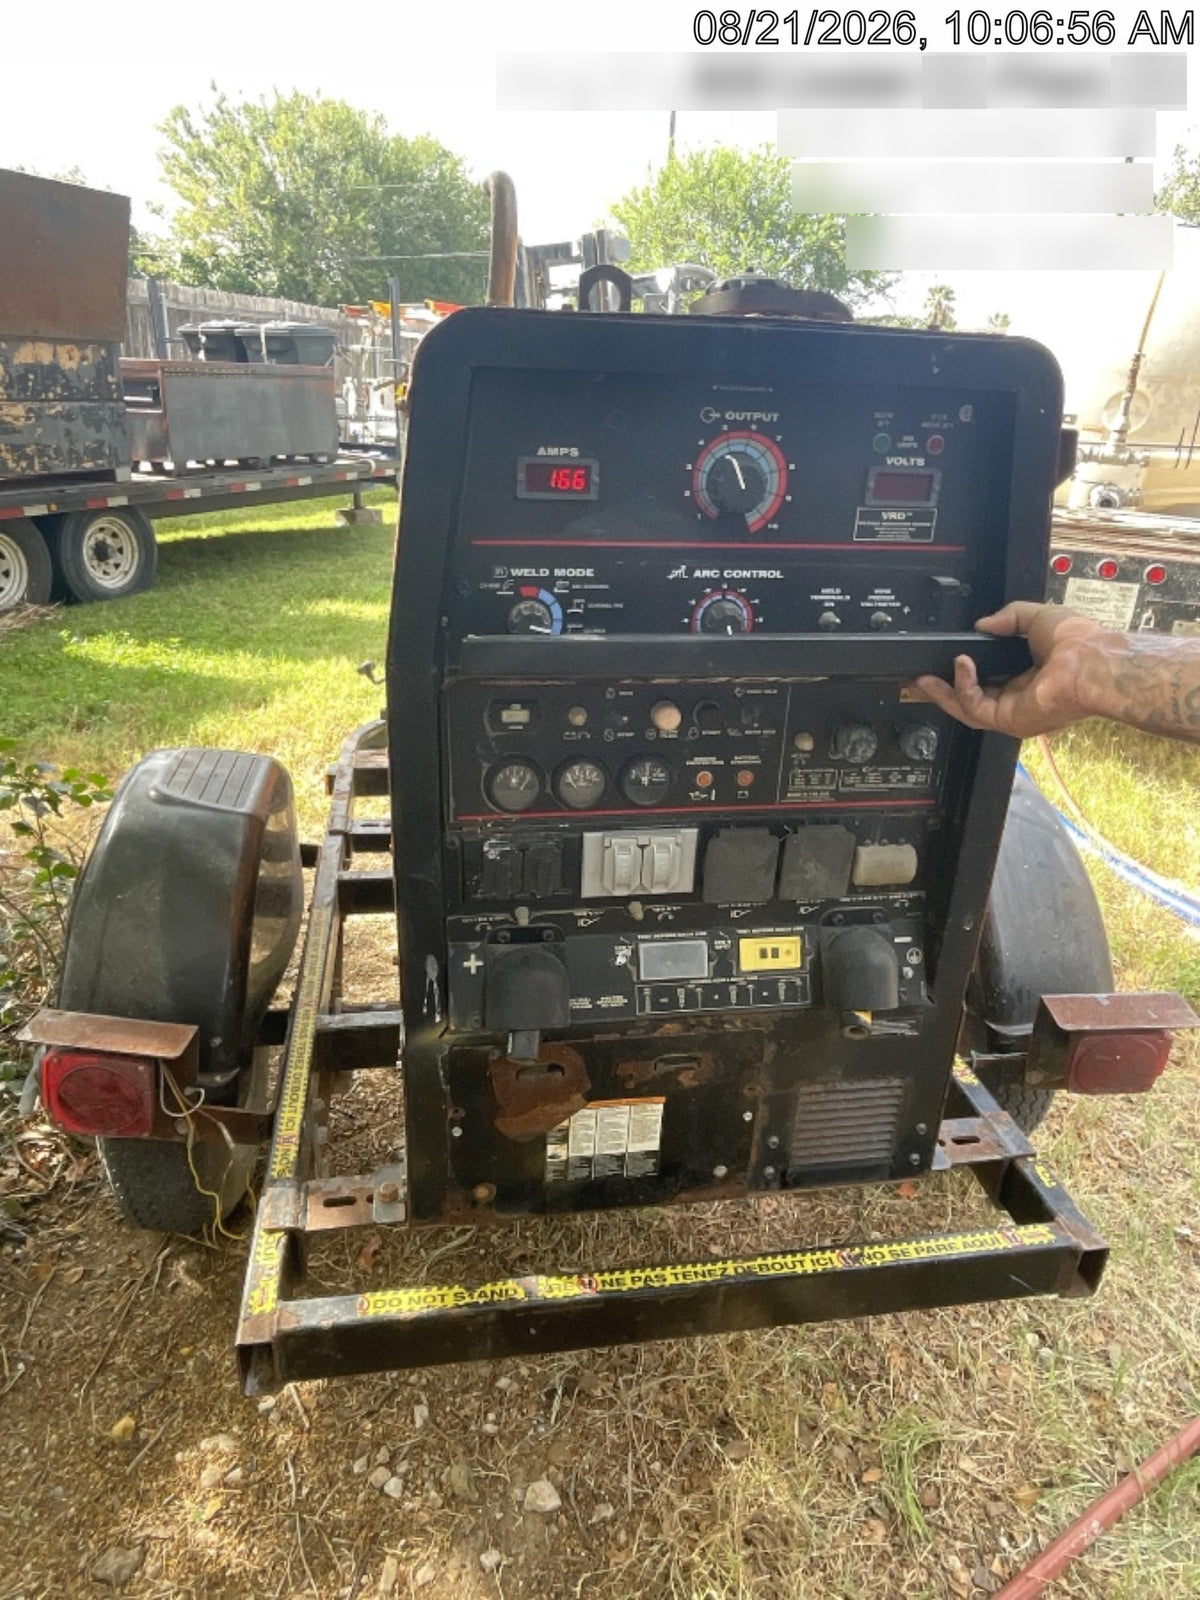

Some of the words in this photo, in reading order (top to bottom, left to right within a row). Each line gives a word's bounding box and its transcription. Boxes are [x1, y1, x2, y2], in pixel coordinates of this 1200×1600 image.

[724, 411, 780, 422] OUTPUT
[536, 446, 580, 457] AMPS
[886, 456, 926, 467] VOLTS
[550, 469, 587, 490] 166
[510, 568, 550, 577] WELD
[553, 568, 595, 577] MODE
[693, 570, 720, 578] ARC
[723, 570, 784, 578] CONTROL
[888, 1248, 912, 1258] SE
[914, 1242, 959, 1256] PARE
[963, 1236, 1001, 1249] AQUI
[602, 1277, 627, 1288] NE
[630, 1272, 667, 1286] PAS
[808, 1256, 834, 1266] ICI
[373, 1298, 402, 1309] DO
[408, 1294, 449, 1306] NOT
